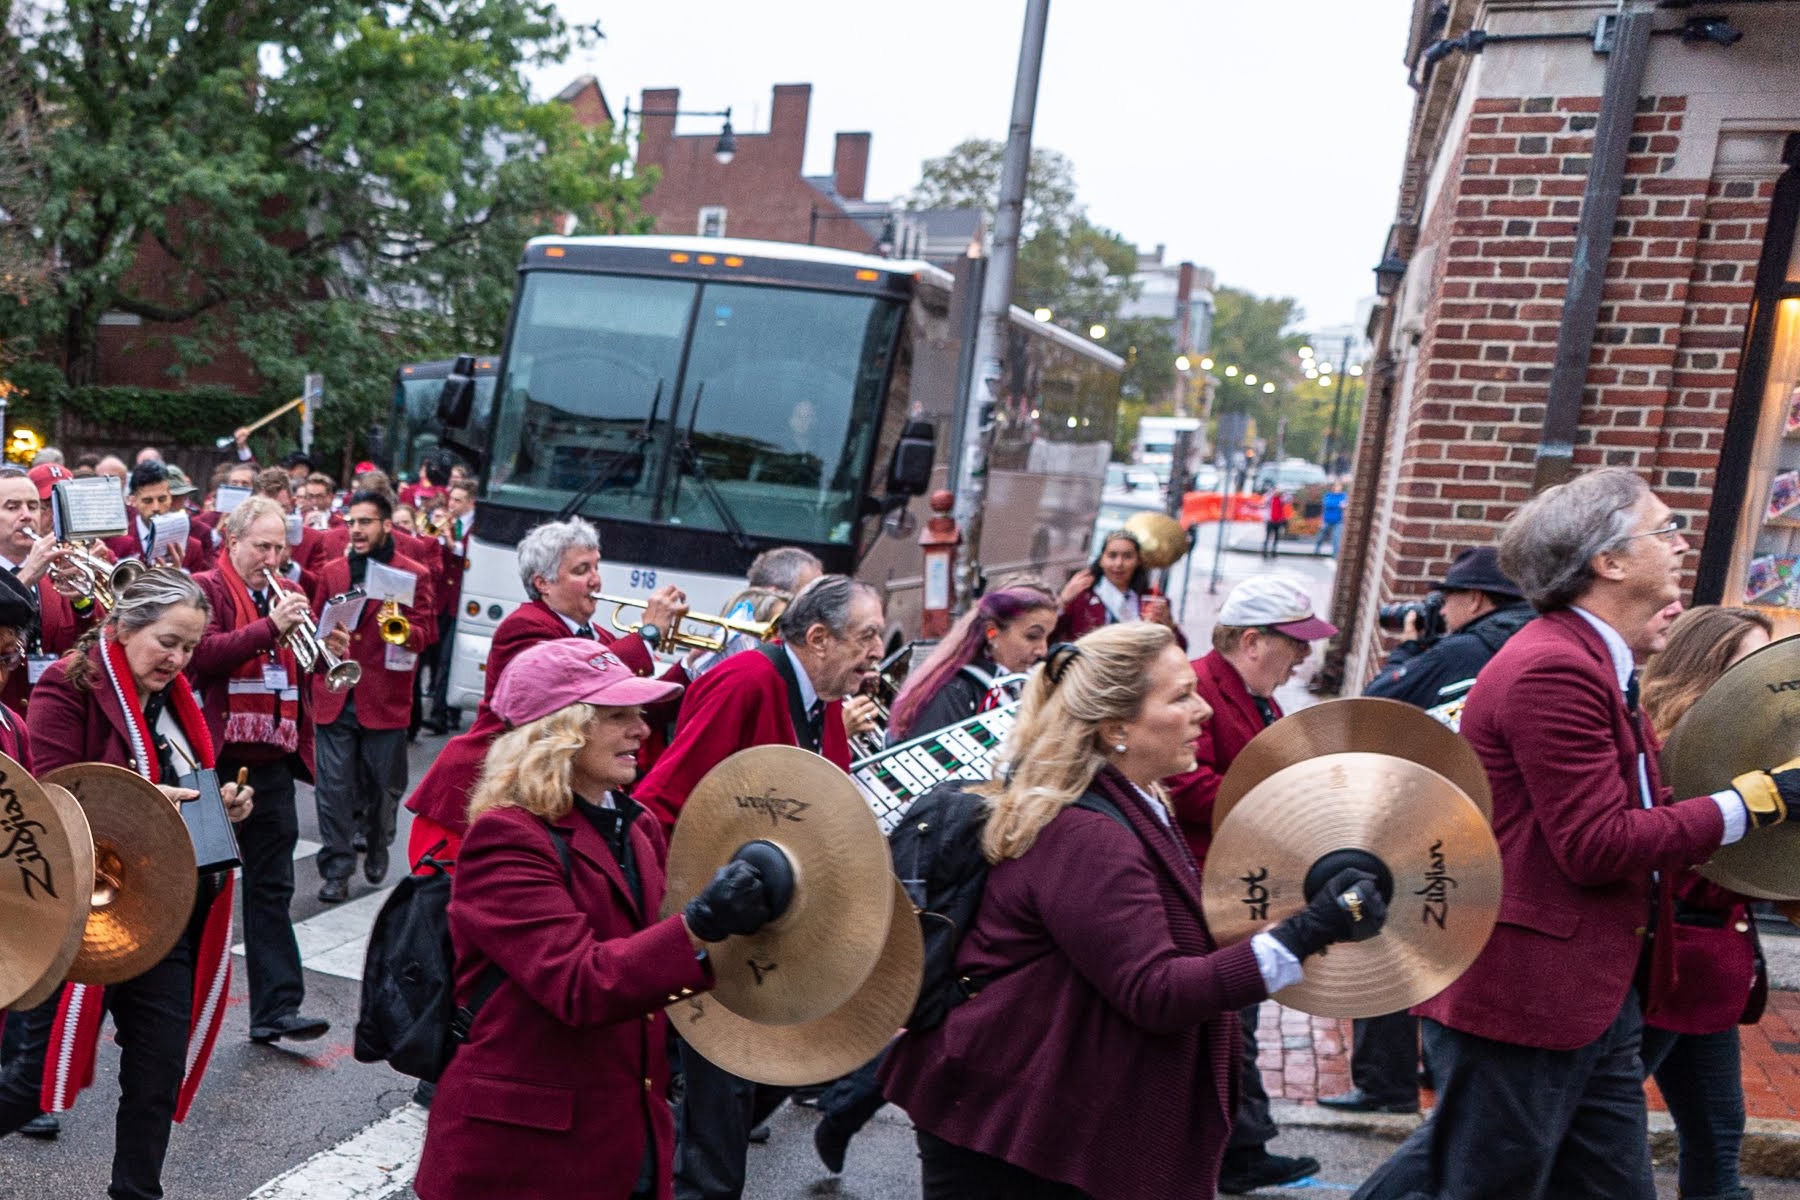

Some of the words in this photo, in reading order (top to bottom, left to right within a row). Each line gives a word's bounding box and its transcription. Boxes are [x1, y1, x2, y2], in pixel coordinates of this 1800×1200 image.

[50, 466, 63, 478] H
[630, 569, 657, 590] 918
[1239, 866, 1269, 921] zbt
[1413, 839, 1458, 930] Zildjian
